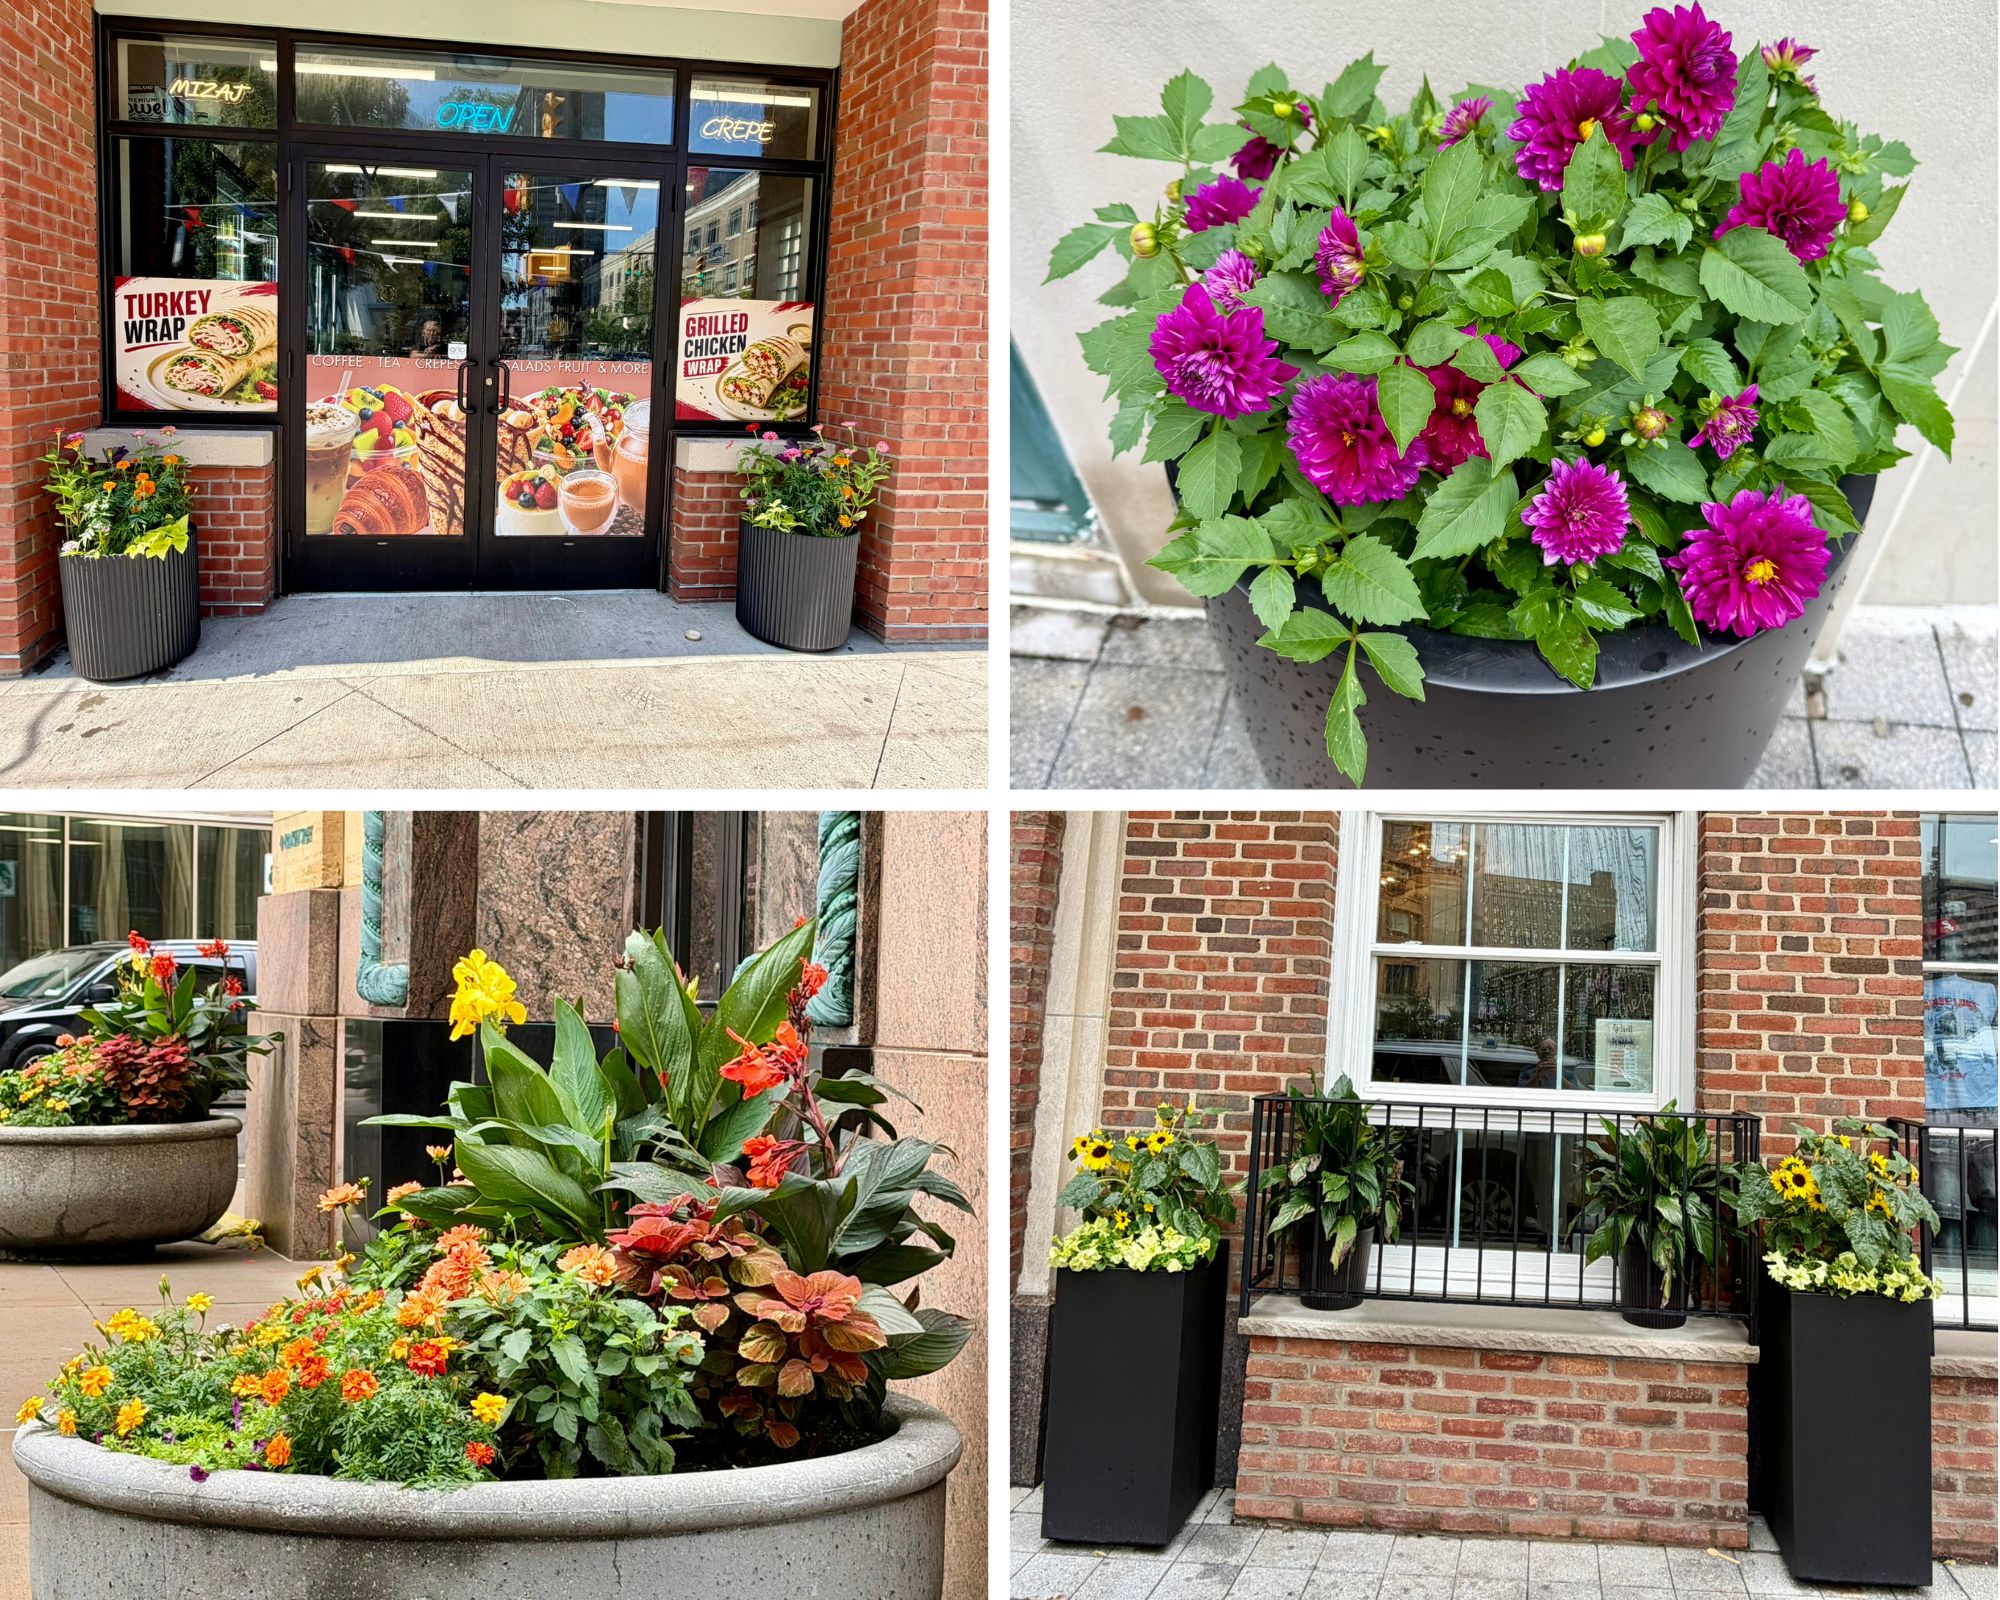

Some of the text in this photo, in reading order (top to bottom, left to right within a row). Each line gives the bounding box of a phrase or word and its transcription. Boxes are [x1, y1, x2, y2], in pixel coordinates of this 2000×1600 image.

[168, 78, 253, 102] MIZAJ
[437, 102, 516, 130] OPEN
[702, 117, 774, 141] CREPE
[124, 289, 212, 320] TURKEY
[124, 317, 186, 344] WRAP
[685, 312, 749, 338] GRILLED
[684, 334, 747, 358] CHICKEN
[312, 355, 363, 368] COFFEE
[377, 357, 401, 368] TEA
[503, 360, 649, 374] SALADS FRUIT & MORE
[687, 359, 722, 376] WRAP
